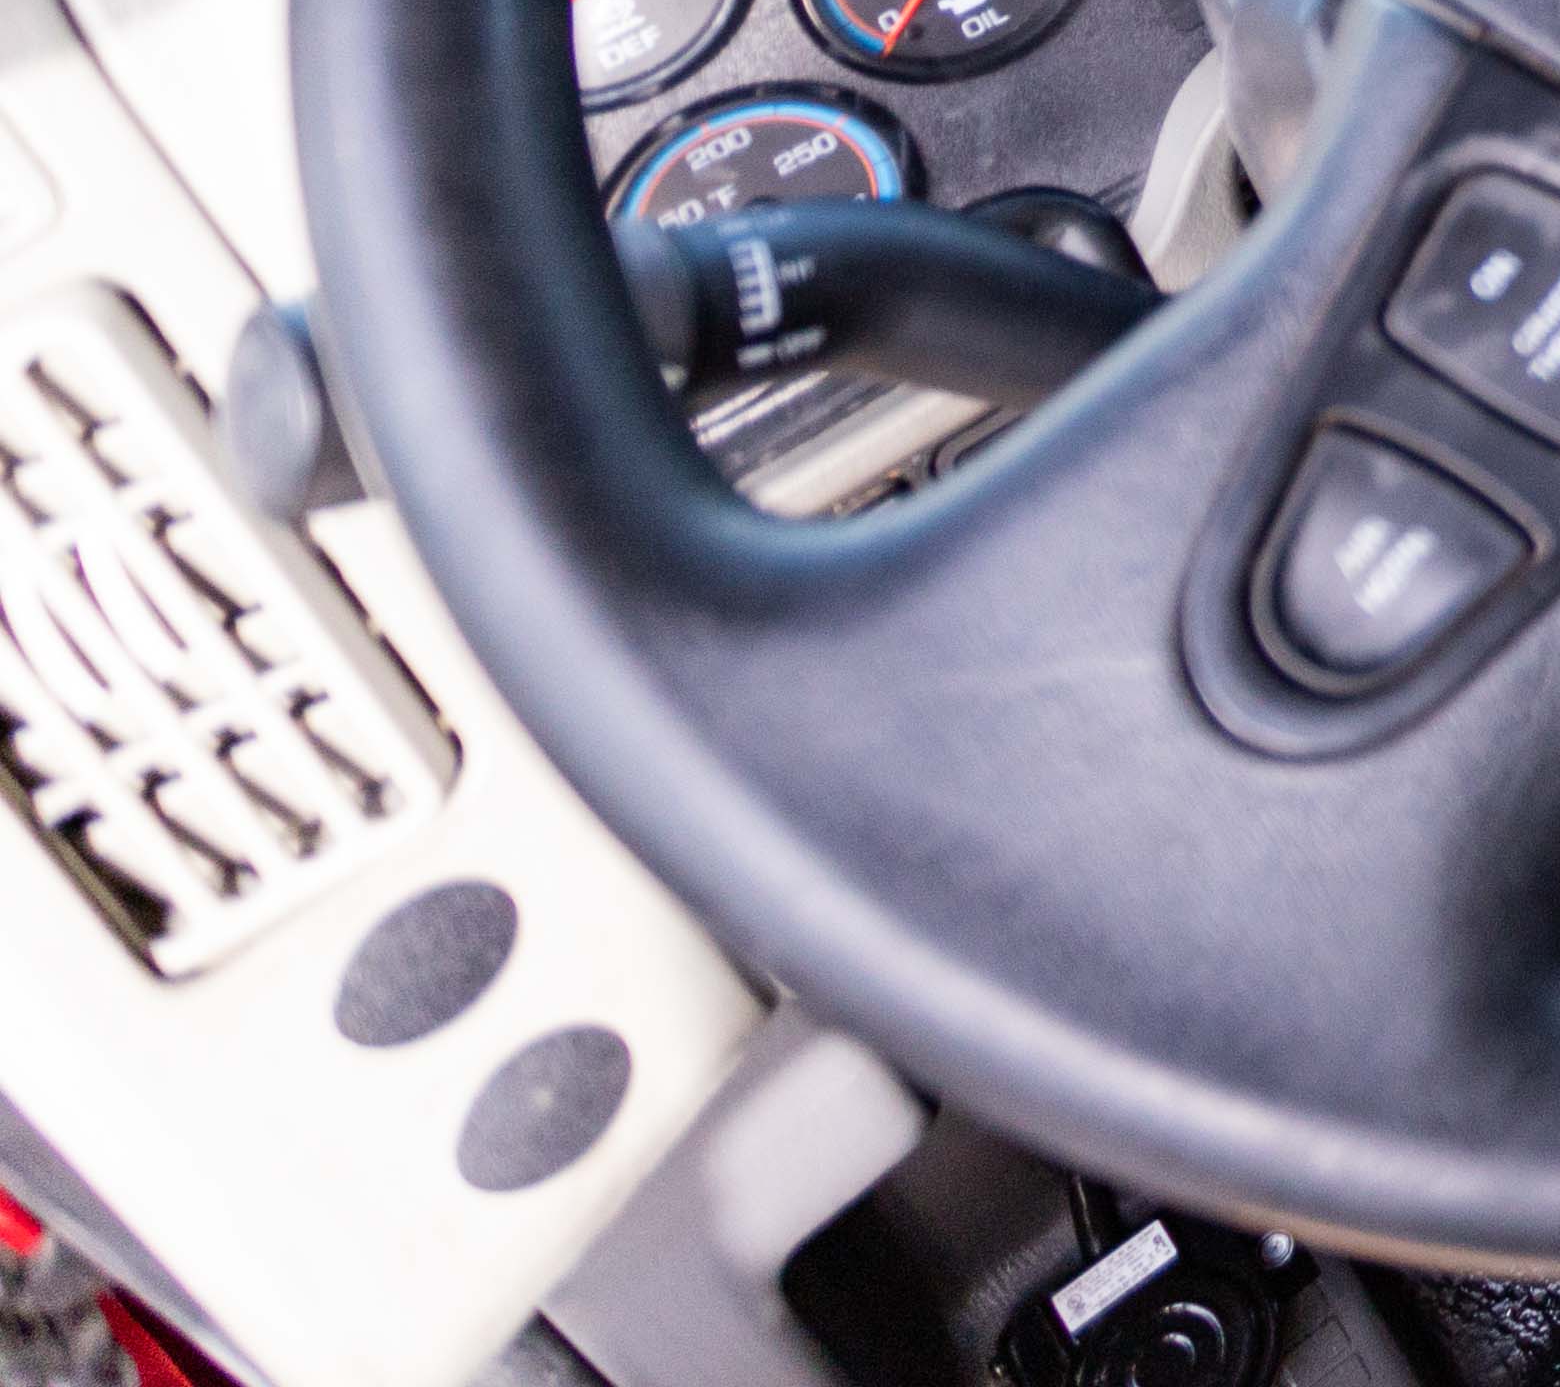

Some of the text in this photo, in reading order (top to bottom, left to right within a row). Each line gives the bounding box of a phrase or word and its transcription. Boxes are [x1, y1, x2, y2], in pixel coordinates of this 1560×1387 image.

[878, 9, 901, 33] 0
[961, 7, 1010, 39] OIL
[598, 25, 662, 70] DEF
[686, 127, 752, 172] 200
[774, 131, 838, 177] 250
